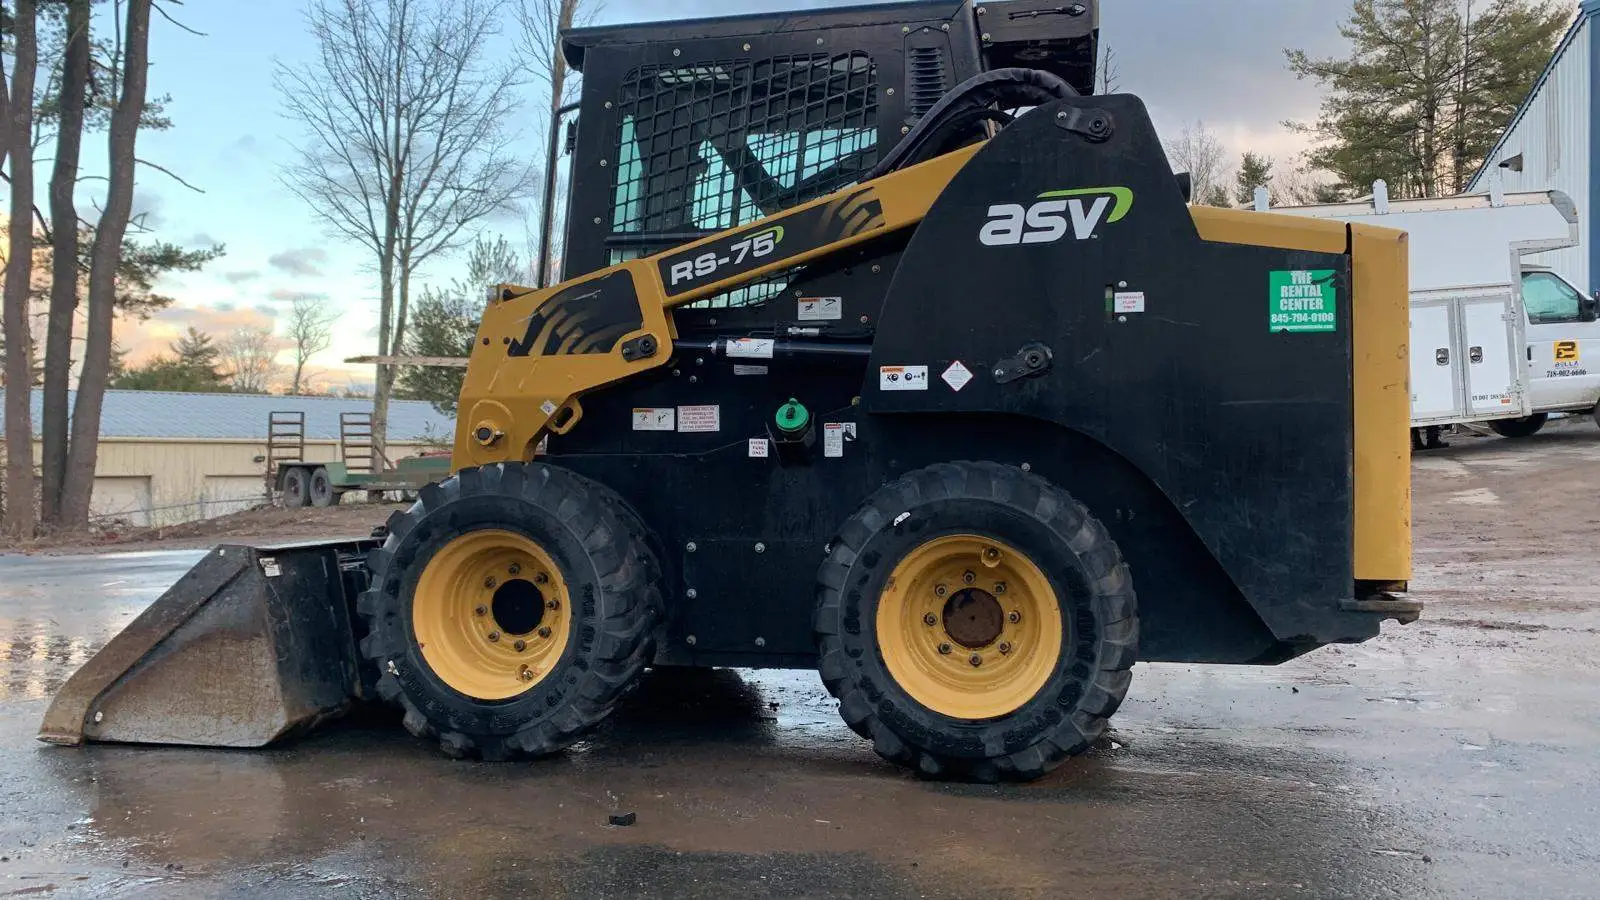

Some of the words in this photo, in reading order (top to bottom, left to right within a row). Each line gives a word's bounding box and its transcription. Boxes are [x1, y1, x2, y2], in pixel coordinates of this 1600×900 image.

[671, 232, 775, 286] RS-75
[1290, 271, 1312, 284] THE
[1280, 284, 1322, 297] RENTAL
[1280, 298, 1323, 310] CENTER
